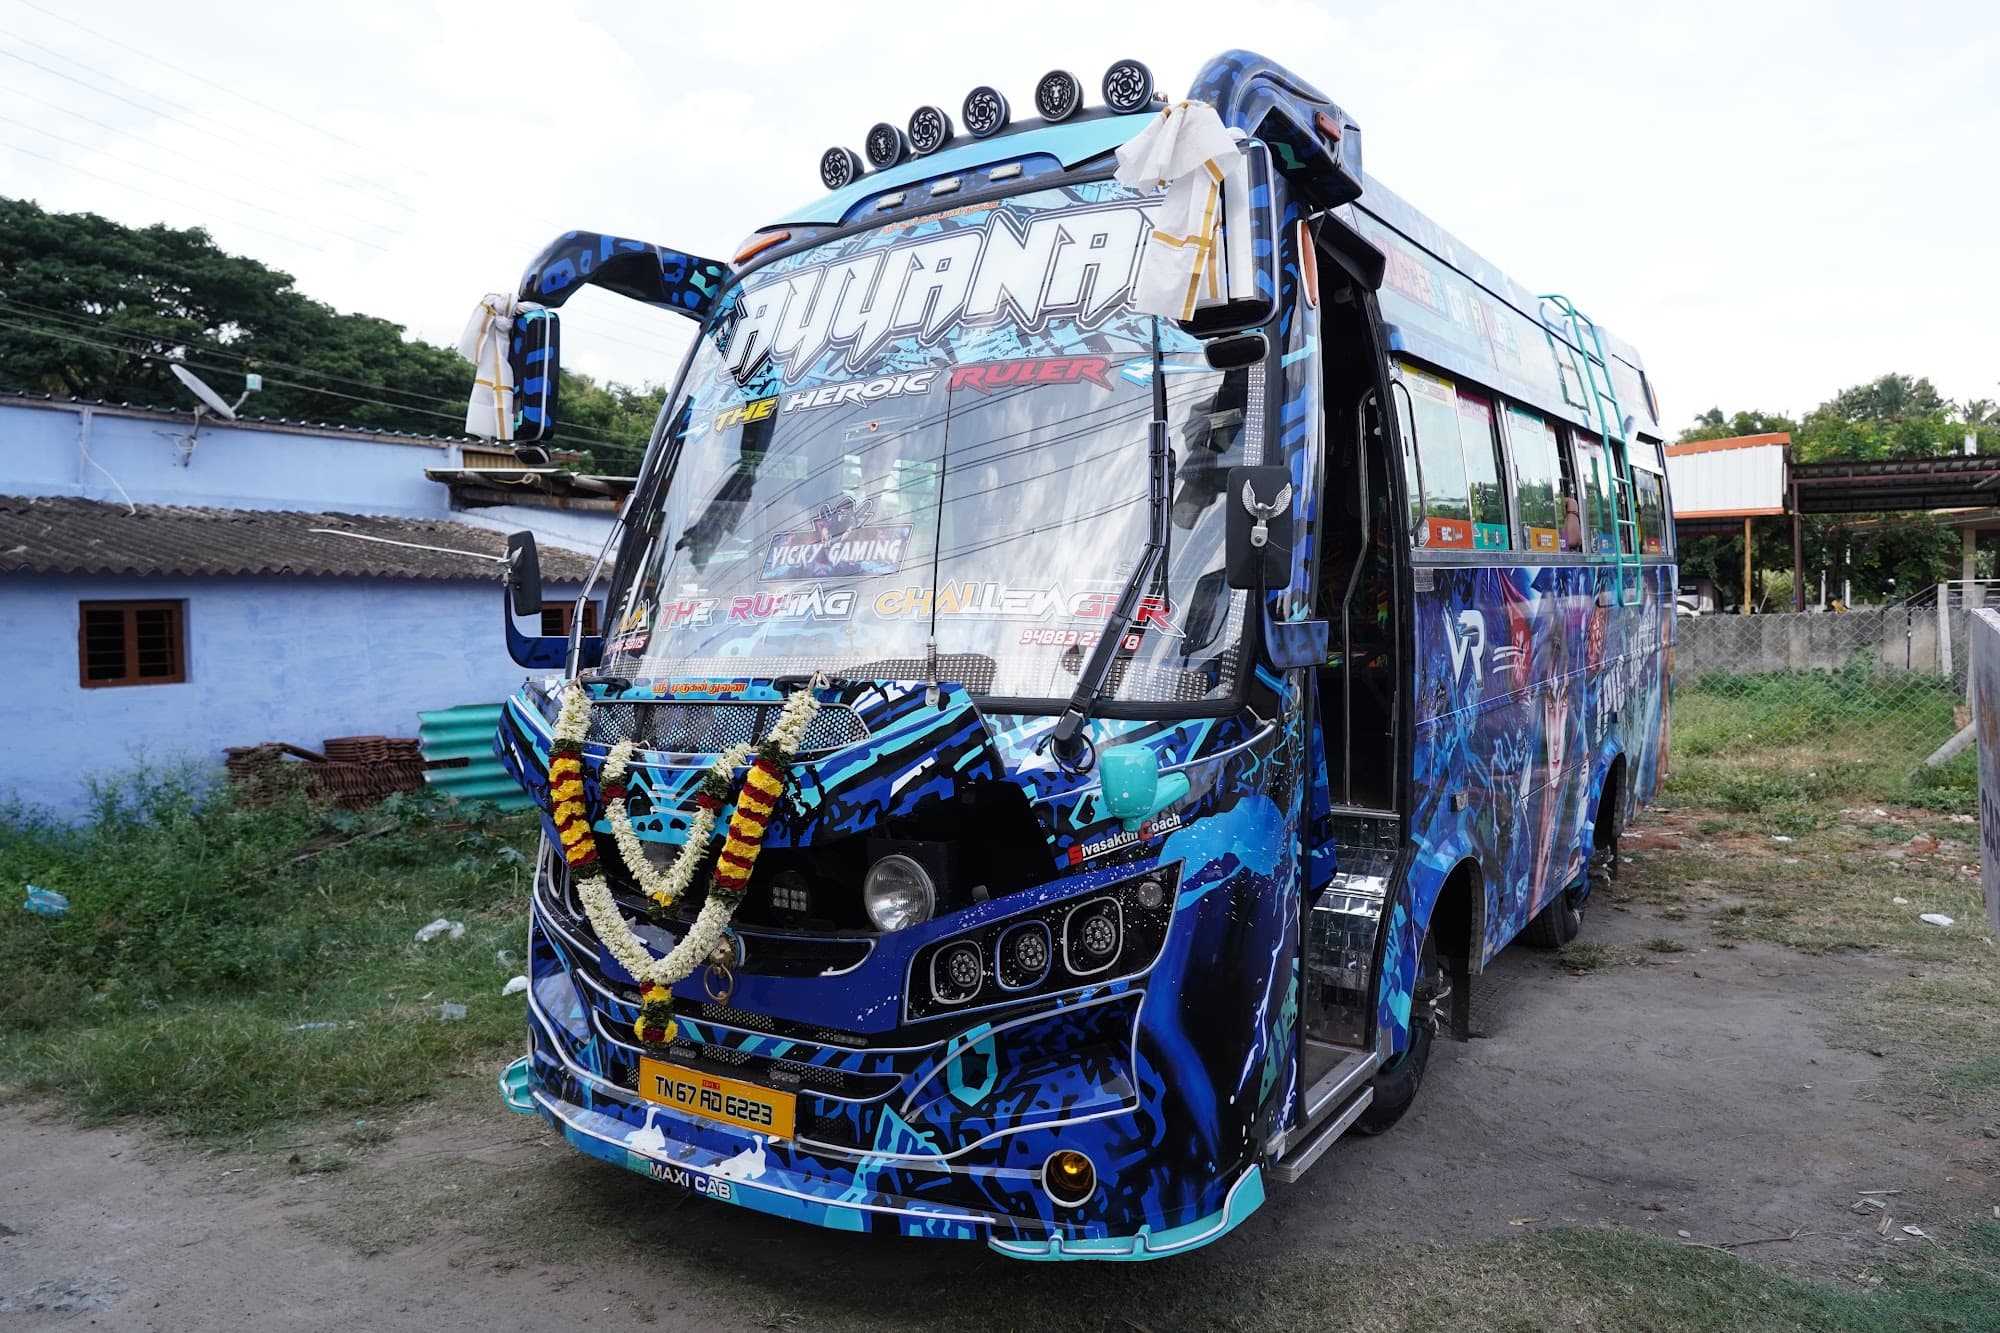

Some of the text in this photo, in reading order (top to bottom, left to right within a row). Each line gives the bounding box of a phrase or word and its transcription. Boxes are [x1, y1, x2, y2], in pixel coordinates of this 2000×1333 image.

[726, 200, 1163, 384] AYYANA
[715, 358, 1113, 431] THE HEROIC RULER
[771, 540, 902, 570] VICKY GAMING
[659, 599, 714, 630] THE
[655, 1075, 674, 1099] TN
[676, 1082, 697, 1105] 67
[700, 1088, 722, 1113] AD
[726, 1095, 773, 1126] 6223
[650, 1162, 732, 1200] MAXI CAB
